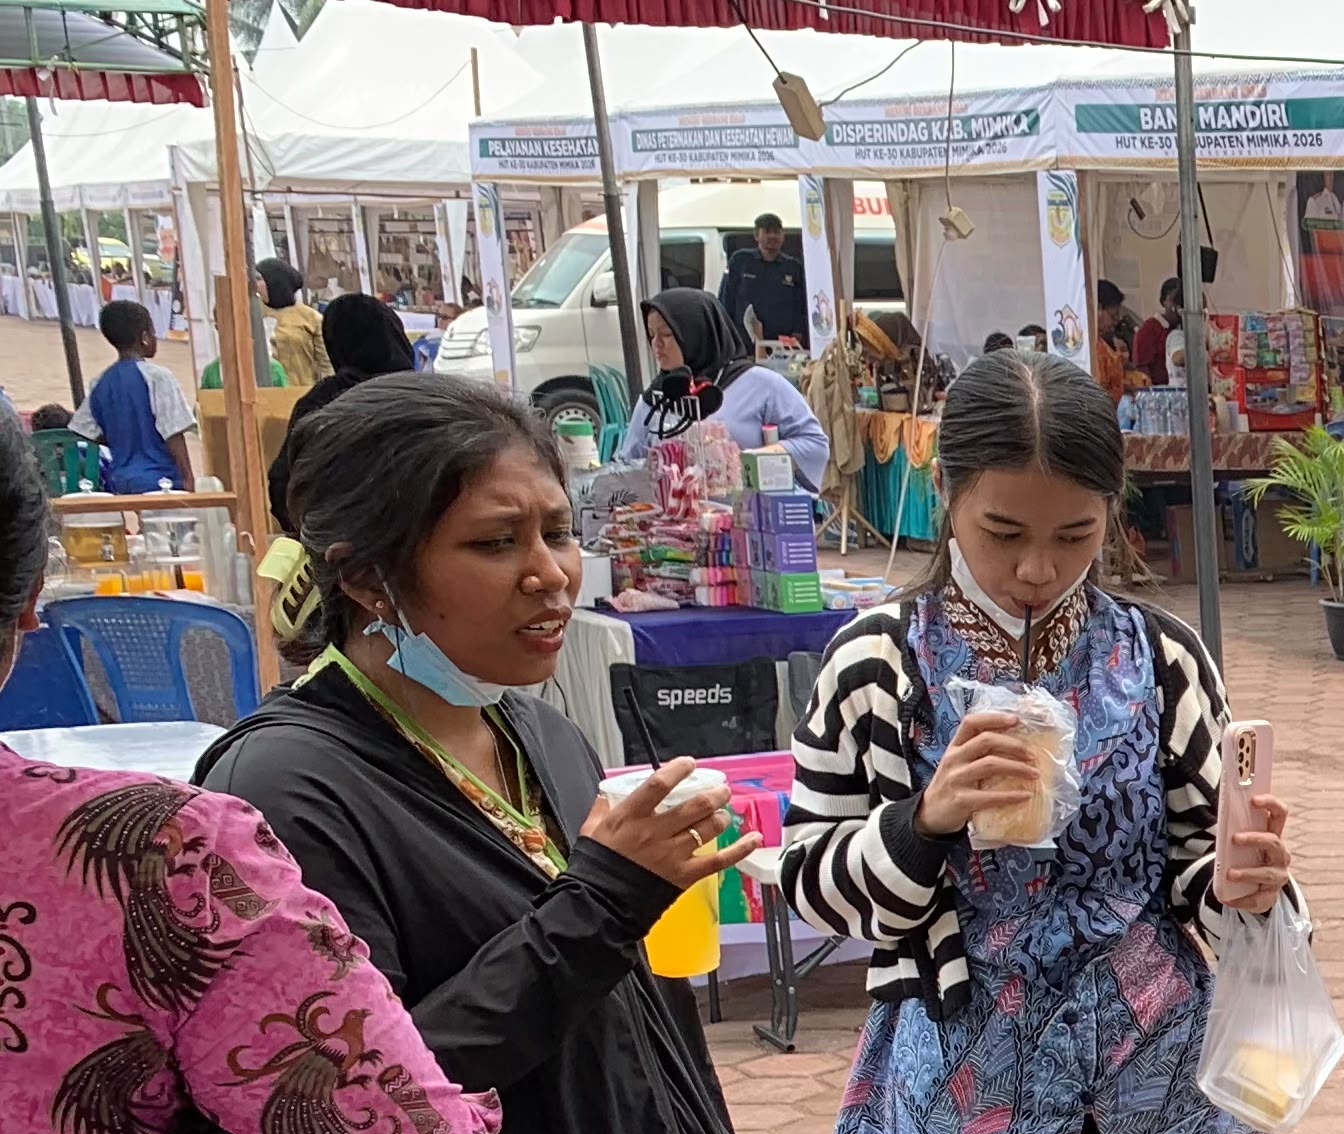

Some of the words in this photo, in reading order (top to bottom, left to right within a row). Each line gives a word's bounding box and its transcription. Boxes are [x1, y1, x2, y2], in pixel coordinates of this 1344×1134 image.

[1139, 107, 1178, 130] BAN
[1198, 103, 1289, 129] MANDIRI
[704, 129, 721, 148] DAN
[832, 120, 929, 144] DISPERINDAG
[931, 120, 967, 140] KAB.
[1116, 136, 1138, 150] HUT
[1140, 136, 1172, 150] KE-30
[1246, 133, 1290, 149] MIMIKA
[1292, 133, 1323, 148] 2026
[488, 140, 541, 157] PELAYANAN
[854, 148, 871, 160] HUT
[873, 147, 898, 160] KE-30
[899, 146, 948, 159] KABUPATEN
[657, 682, 732, 711] speeds
